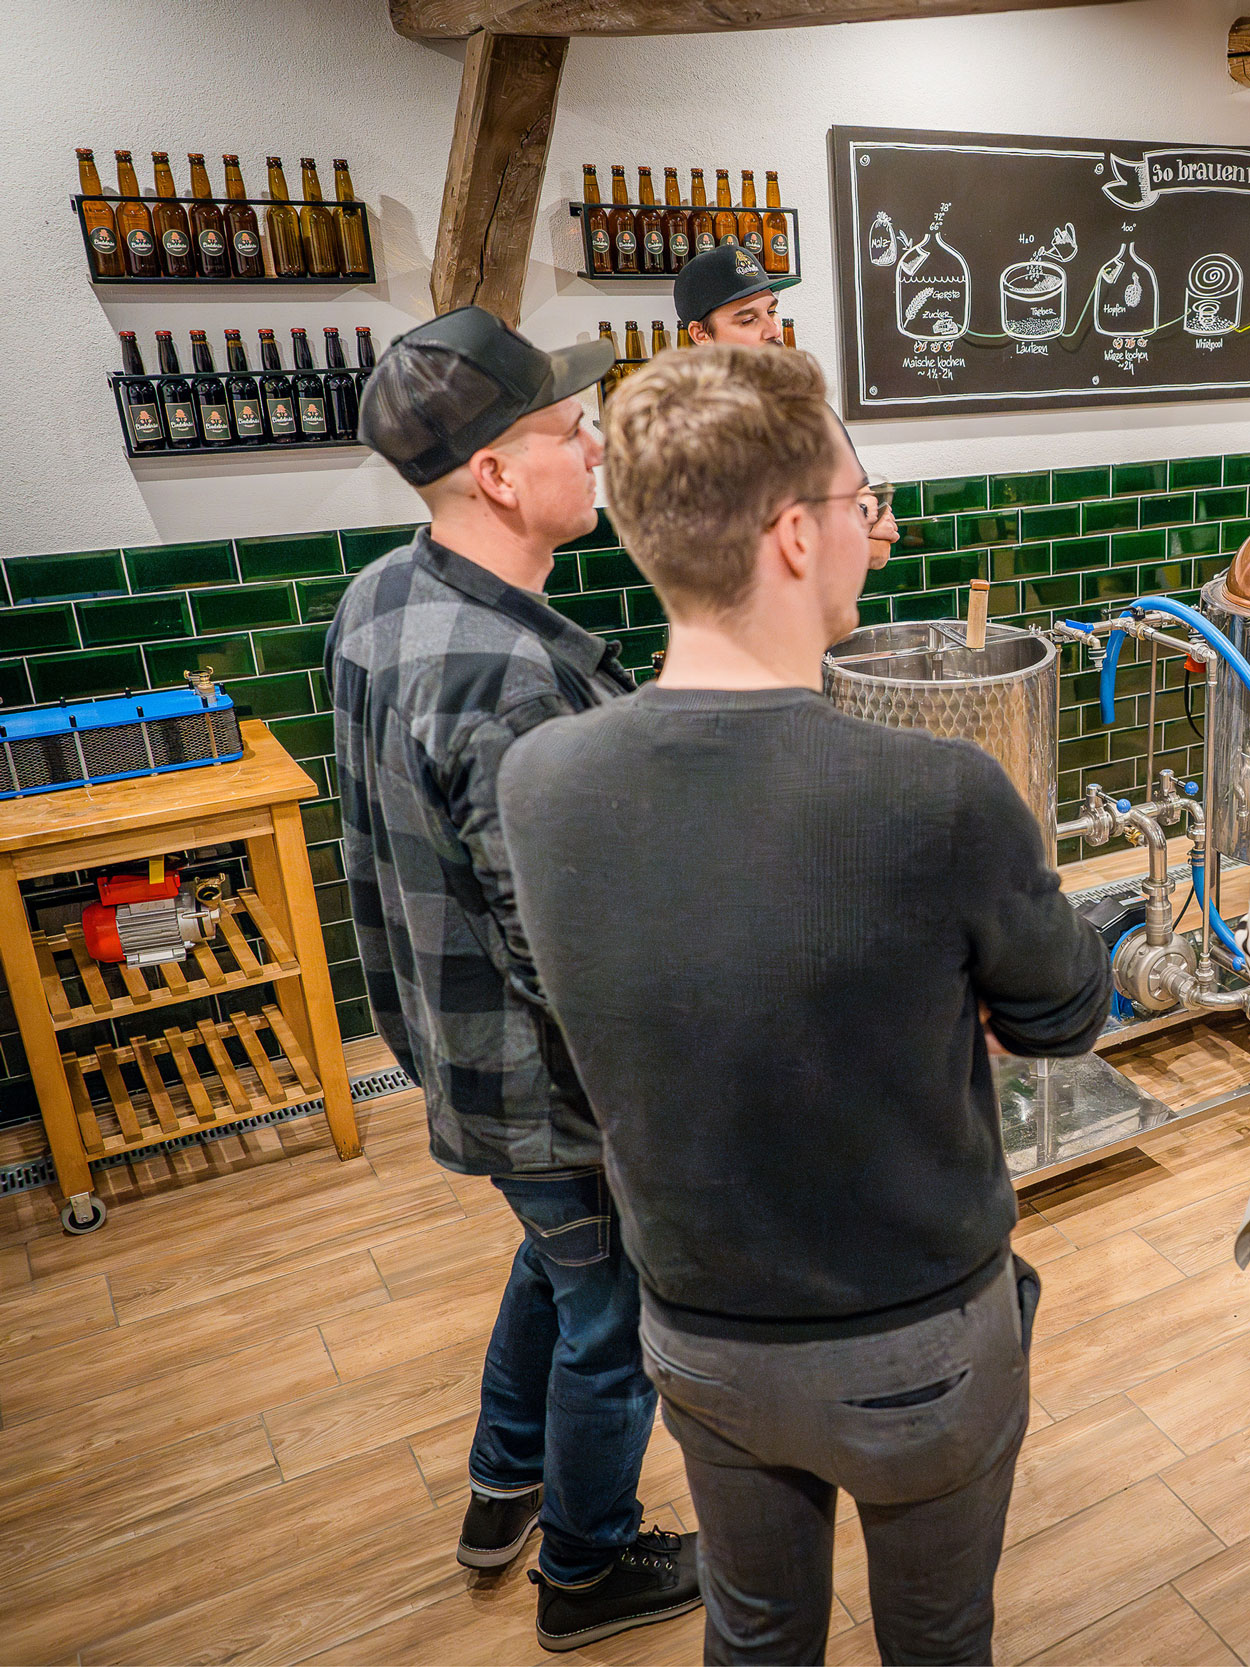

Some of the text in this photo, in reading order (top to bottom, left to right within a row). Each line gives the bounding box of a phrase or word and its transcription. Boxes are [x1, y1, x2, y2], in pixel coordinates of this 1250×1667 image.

[1152, 164, 1173, 182] So
[1176, 159, 1246, 182] brauen
[931, 290, 961, 301] Gerste
[922, 309, 953, 319] Zucker
[1030, 306, 1057, 316] Treber
[1103, 304, 1127, 317] Hopfen
[1016, 342, 1049, 356] Läutern
[1195, 338, 1224, 352] Whirlpool
[902, 354, 966, 370] Maische kochen
[1124, 348, 1149, 364] kochen
